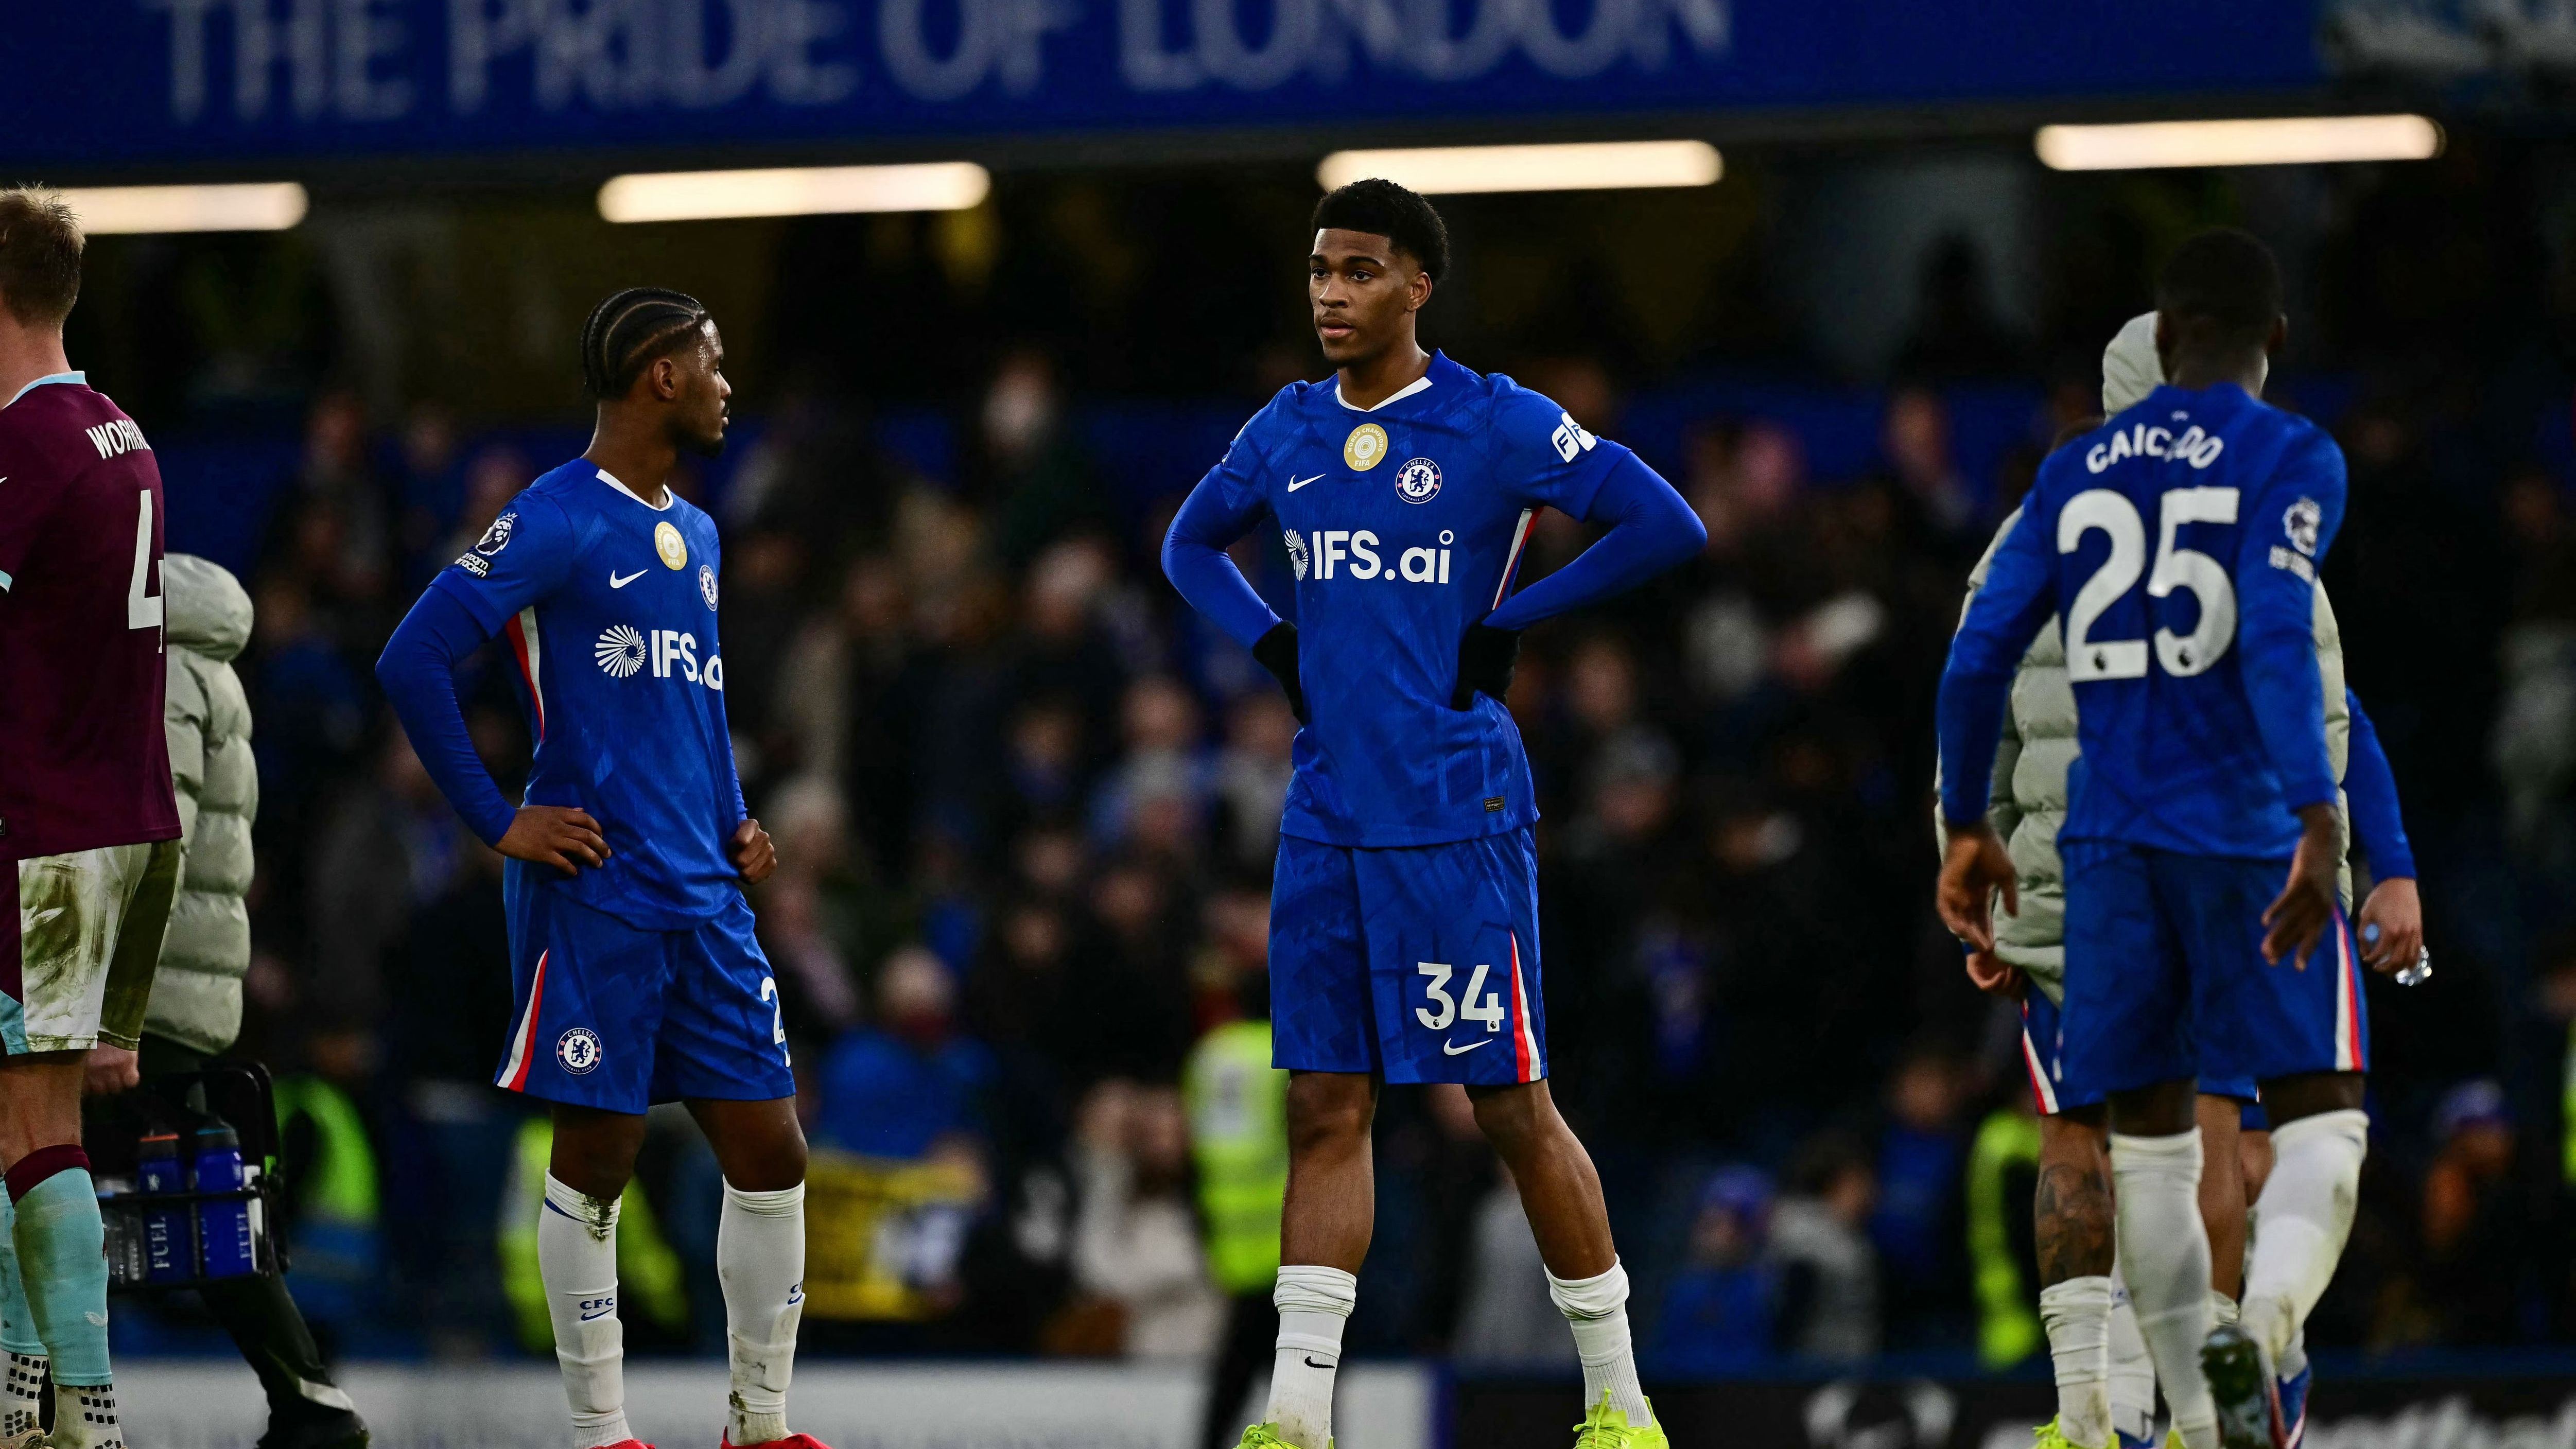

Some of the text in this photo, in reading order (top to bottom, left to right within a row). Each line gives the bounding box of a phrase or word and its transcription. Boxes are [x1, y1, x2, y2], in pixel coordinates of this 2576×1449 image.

[147, 0, 1733, 124] THE PRIDE OF LONDON
[1347, 427, 1384, 453] WORLD CHAMPIONS
[1405, 460, 1434, 470] CHELSEA
[2086, 423, 2224, 474] CAICDO
[1401, 492, 1420, 501] FOOTBALL
[128, 489, 164, 653] 4
[1313, 530, 1454, 584] IFS.ai
[2057, 485, 2240, 684] 25
[651, 630, 723, 691] IFS.a
[761, 976, 786, 1044] 2
[1416, 962, 1505, 1032] 34
[568, 1029, 596, 1042] CHELSEA
[149, 1216, 170, 1268] FUEL
[580, 1298, 614, 1310] CFC
